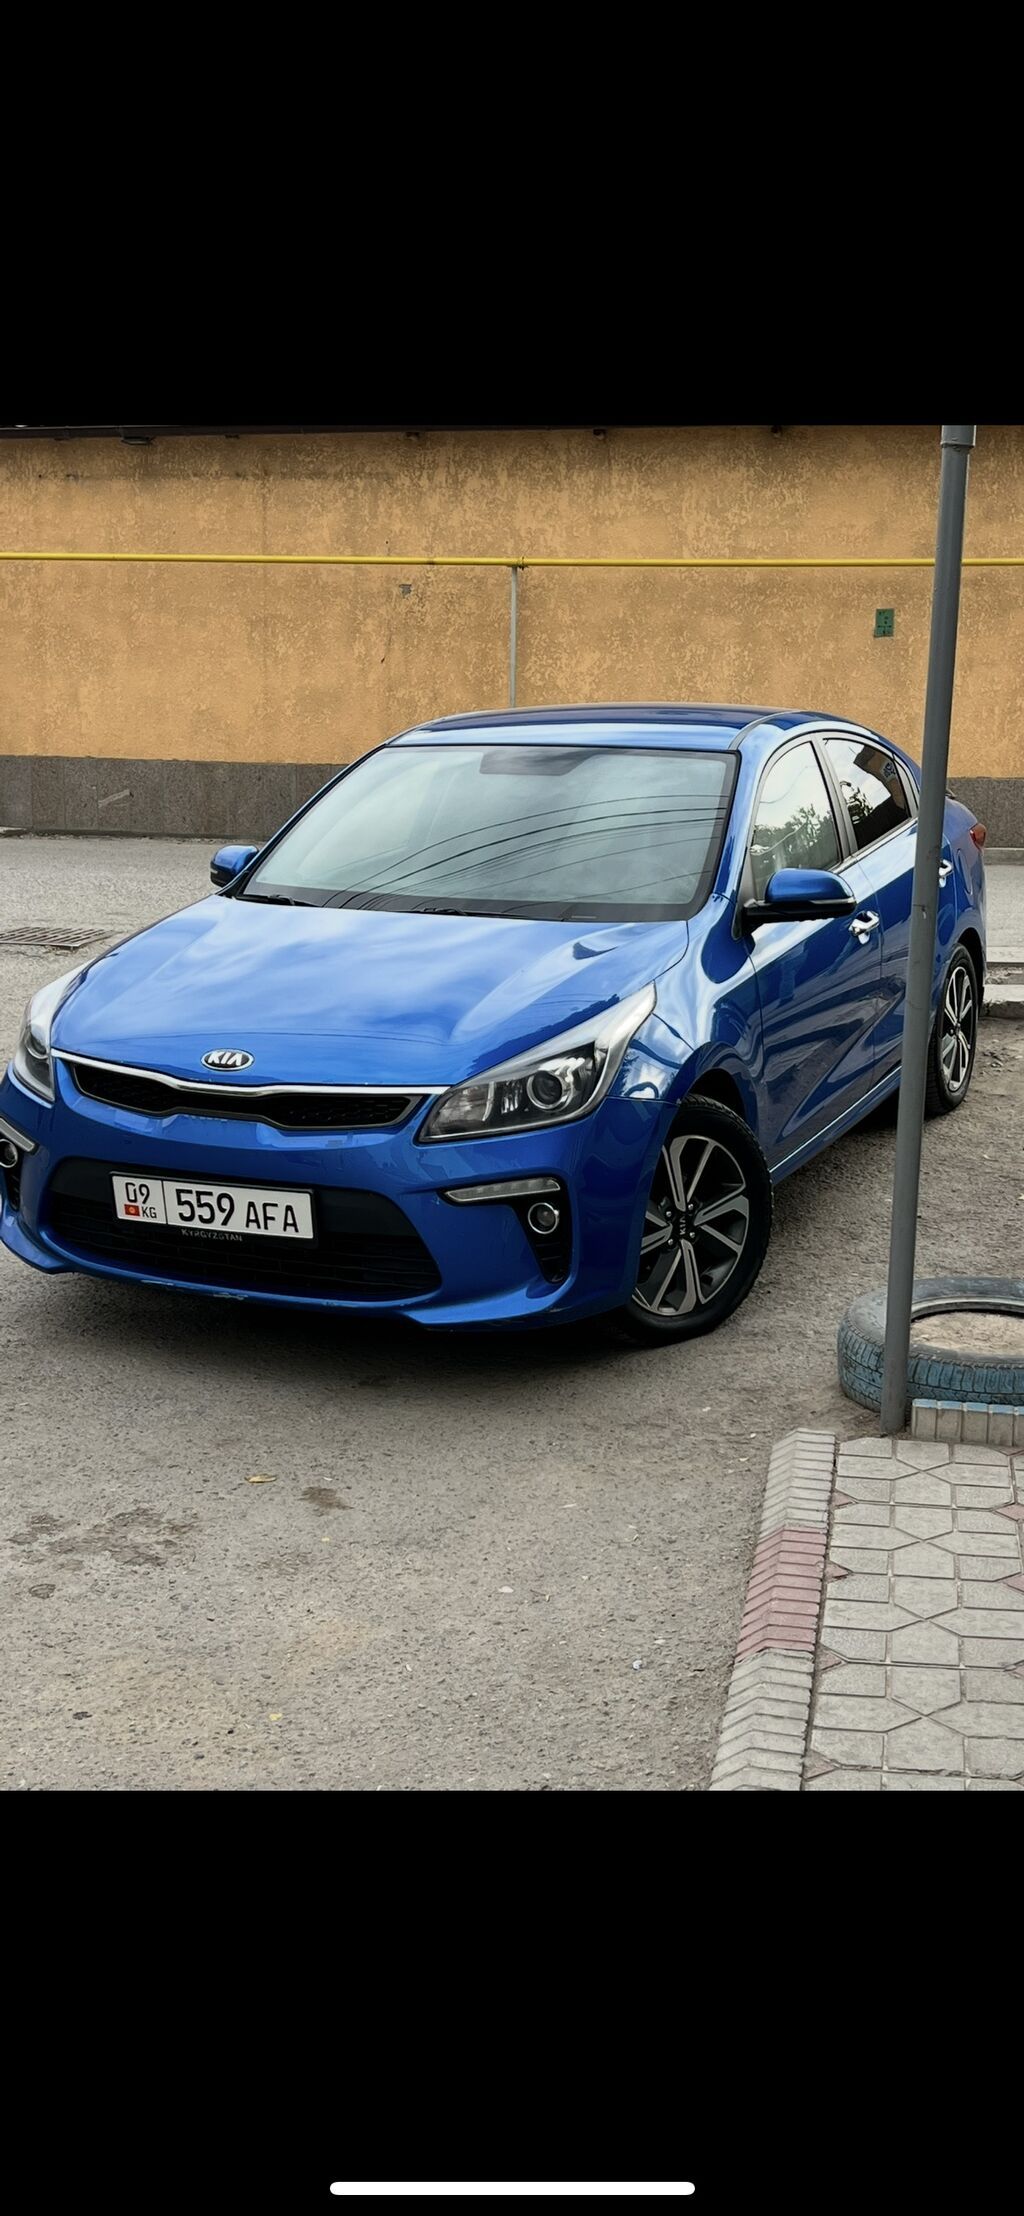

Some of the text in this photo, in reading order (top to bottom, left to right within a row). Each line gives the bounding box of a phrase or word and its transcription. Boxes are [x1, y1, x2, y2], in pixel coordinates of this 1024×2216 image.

[207, 1051, 243, 1066] KIA
[125, 1182, 150, 1204] 09
[141, 1206, 157, 1219] KG
[175, 1188, 299, 1233] 559 AFA
